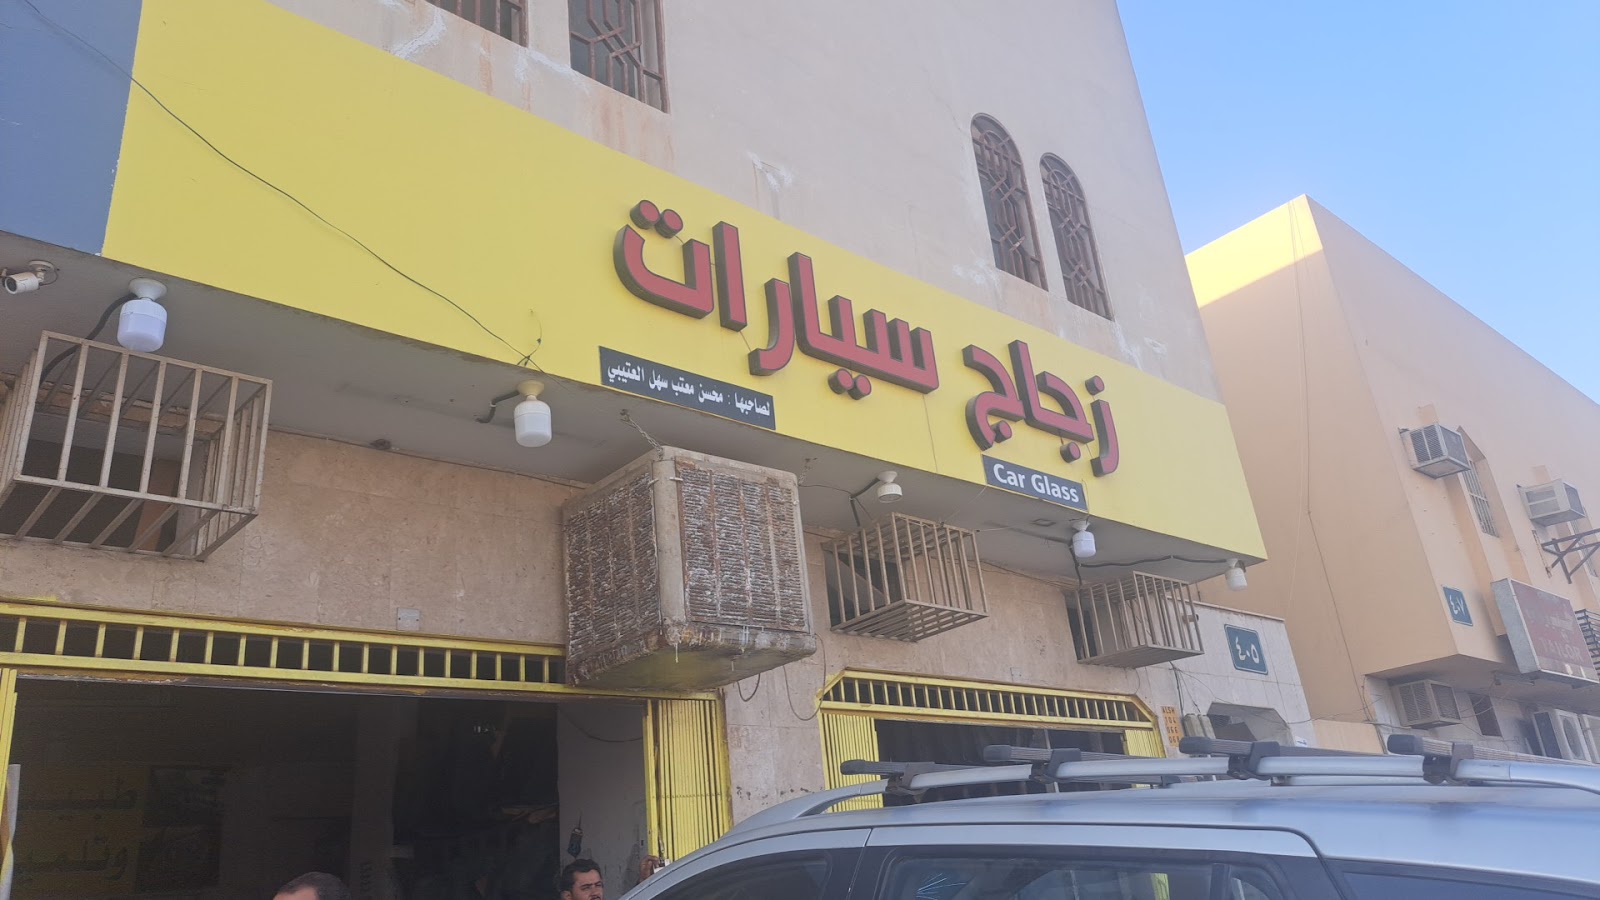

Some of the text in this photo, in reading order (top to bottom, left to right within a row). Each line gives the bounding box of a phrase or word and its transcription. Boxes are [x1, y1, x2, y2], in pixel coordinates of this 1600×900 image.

[613, 199, 1120, 478] زجاج سيارات
[607, 361, 645, 383] العتيبي
[649, 368, 669, 392] سهل
[671, 376, 695, 397] معتب
[698, 382, 724, 403] محسن
[734, 392, 771, 416] لصاحبها
[993, 463, 1079, 503] Car Glass
[1235, 636, 1260, 664] ٤٠٥
